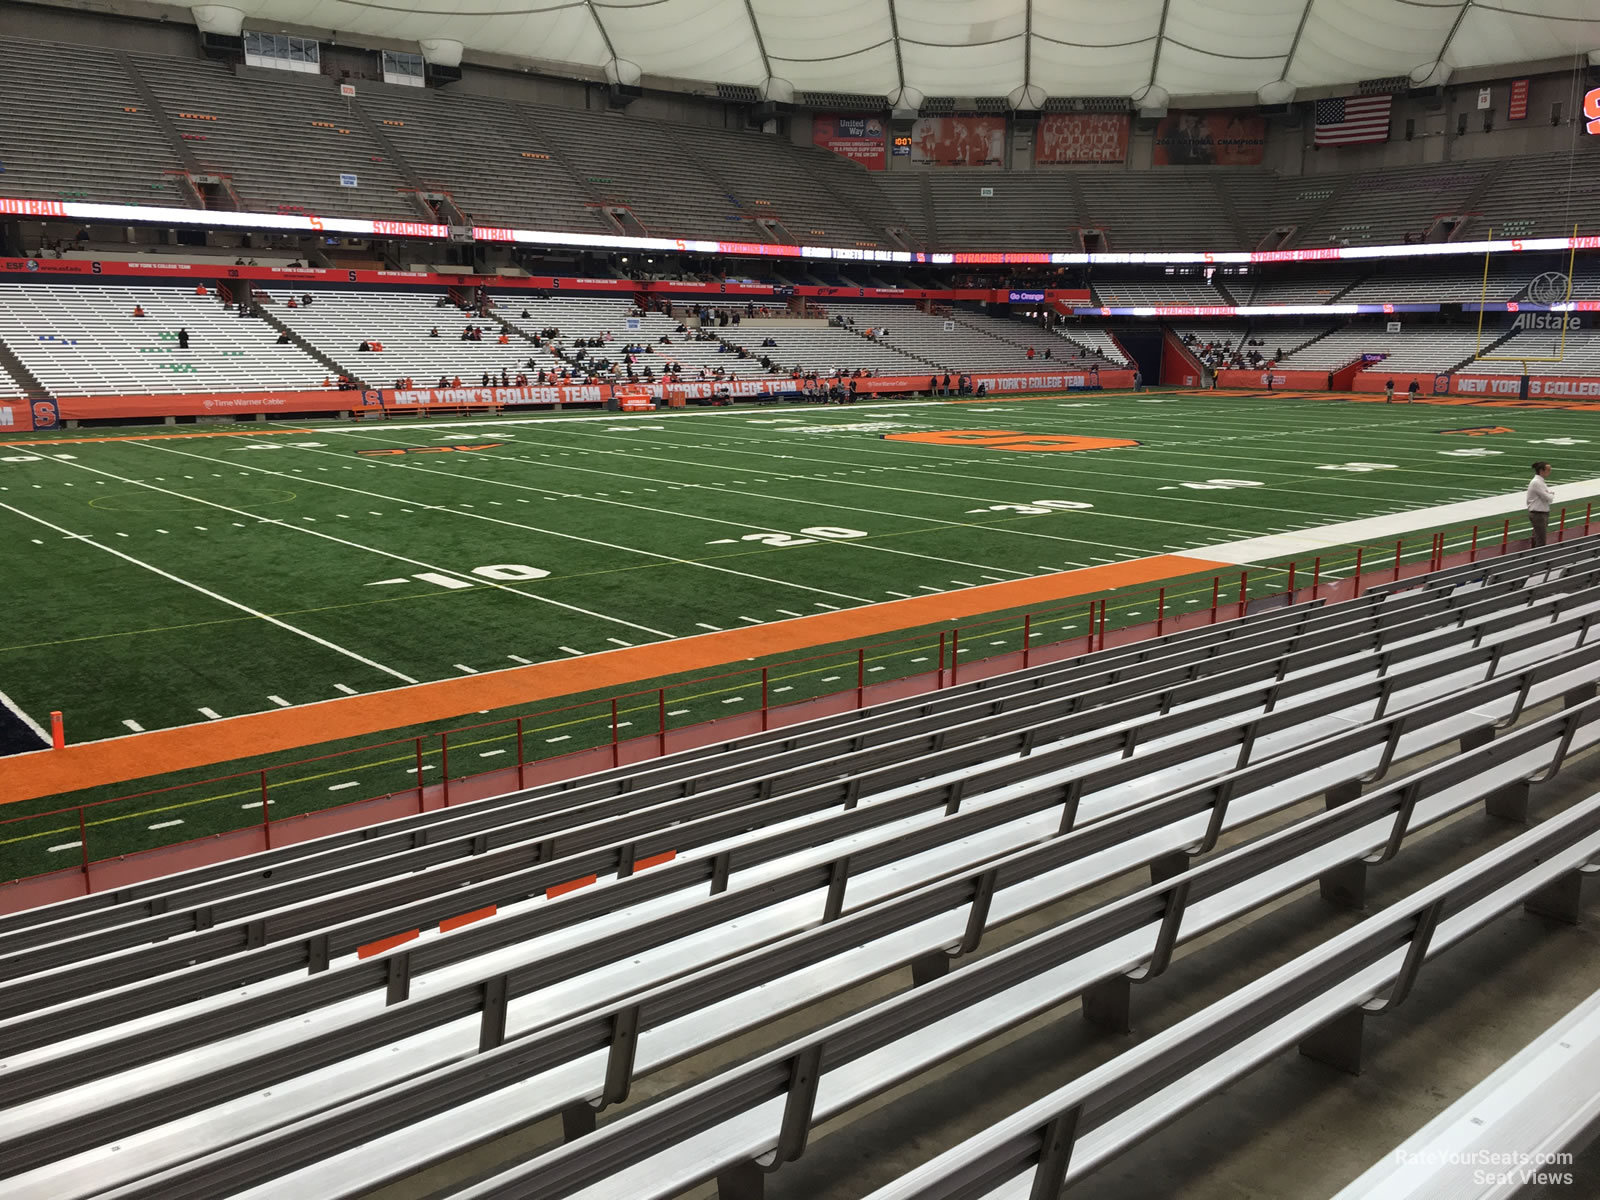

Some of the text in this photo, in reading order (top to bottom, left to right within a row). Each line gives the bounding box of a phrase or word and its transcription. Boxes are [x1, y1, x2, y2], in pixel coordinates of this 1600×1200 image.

[849, 128, 863, 136] Way
[310, 216, 323, 231] S
[373, 221, 434, 237] SYRACUSE
[1512, 240, 1523, 251] S
[955, 253, 1003, 263] SYRACUSE
[1005, 253, 1049, 263] FOOTBALL
[1204, 252, 1214, 263] S
[1250, 248, 1340, 263] SYRACUSE FOOTBALL
[6, 262, 24, 270] ESF
[92, 261, 102, 274] S
[349, 270, 357, 281] S
[553, 278, 560, 288] S
[720, 284, 728, 293] S
[1010, 292, 1044, 301] Go Orange
[1155, 307, 1236, 316] SYRACUSE FOOTBALL
[1511, 313, 1581, 330] Allstate
[767, 381, 796, 395] TEAM
[998, 378, 1027, 389] YORK'S
[1029, 377, 1062, 388] COLLEGE
[1064, 376, 1085, 387] TEAM
[1435, 376, 1449, 392] S
[1458, 379, 1488, 392] NEW
[395, 387, 600, 405] NEW YORK'S COLLEGE TEAM
[33, 401, 56, 427] S
[989, 500, 1094, 514] 30
[742, 526, 868, 547] 20
[411, 564, 551, 589] 10
